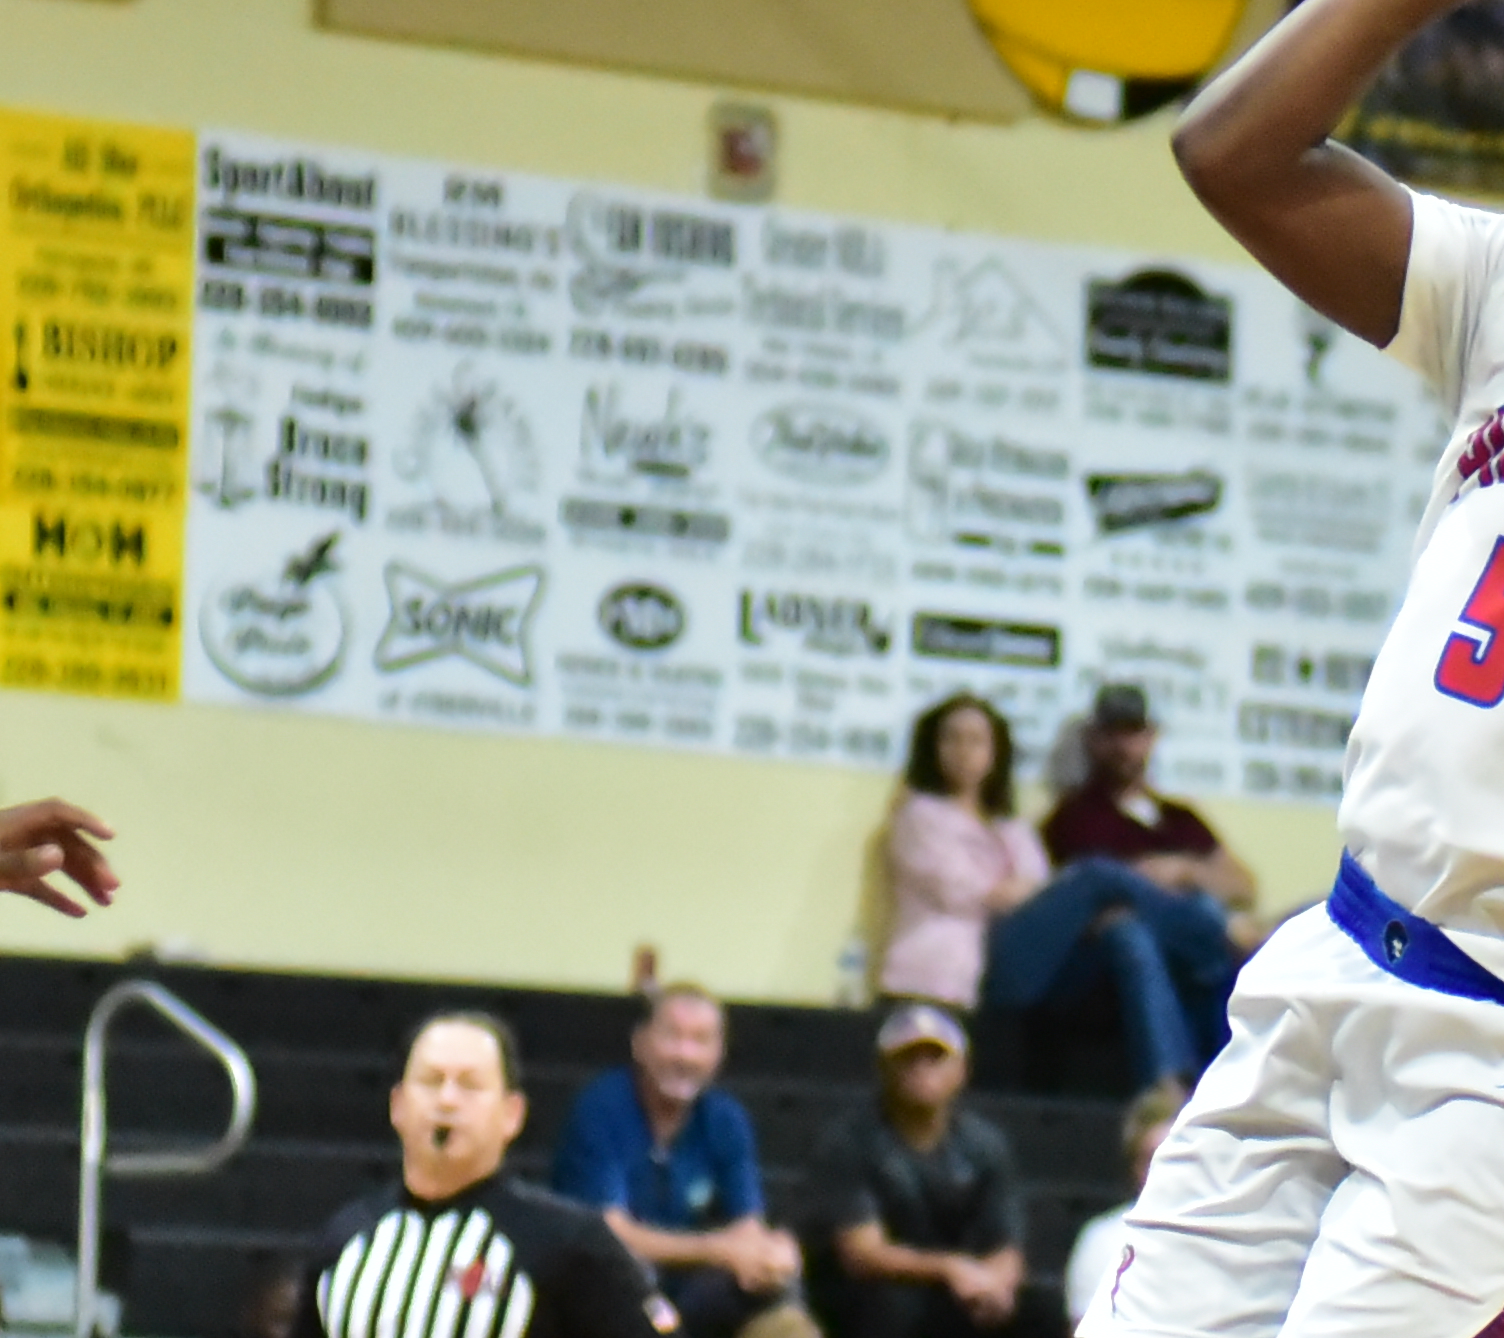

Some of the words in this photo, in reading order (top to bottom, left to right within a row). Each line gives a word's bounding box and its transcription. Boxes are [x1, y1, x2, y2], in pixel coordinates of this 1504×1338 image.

[202, 143, 377, 212] SportAbout
[43, 318, 178, 369] BISHOP
[267, 458, 369, 524] Strong
[401, 595, 518, 648] SONIC
